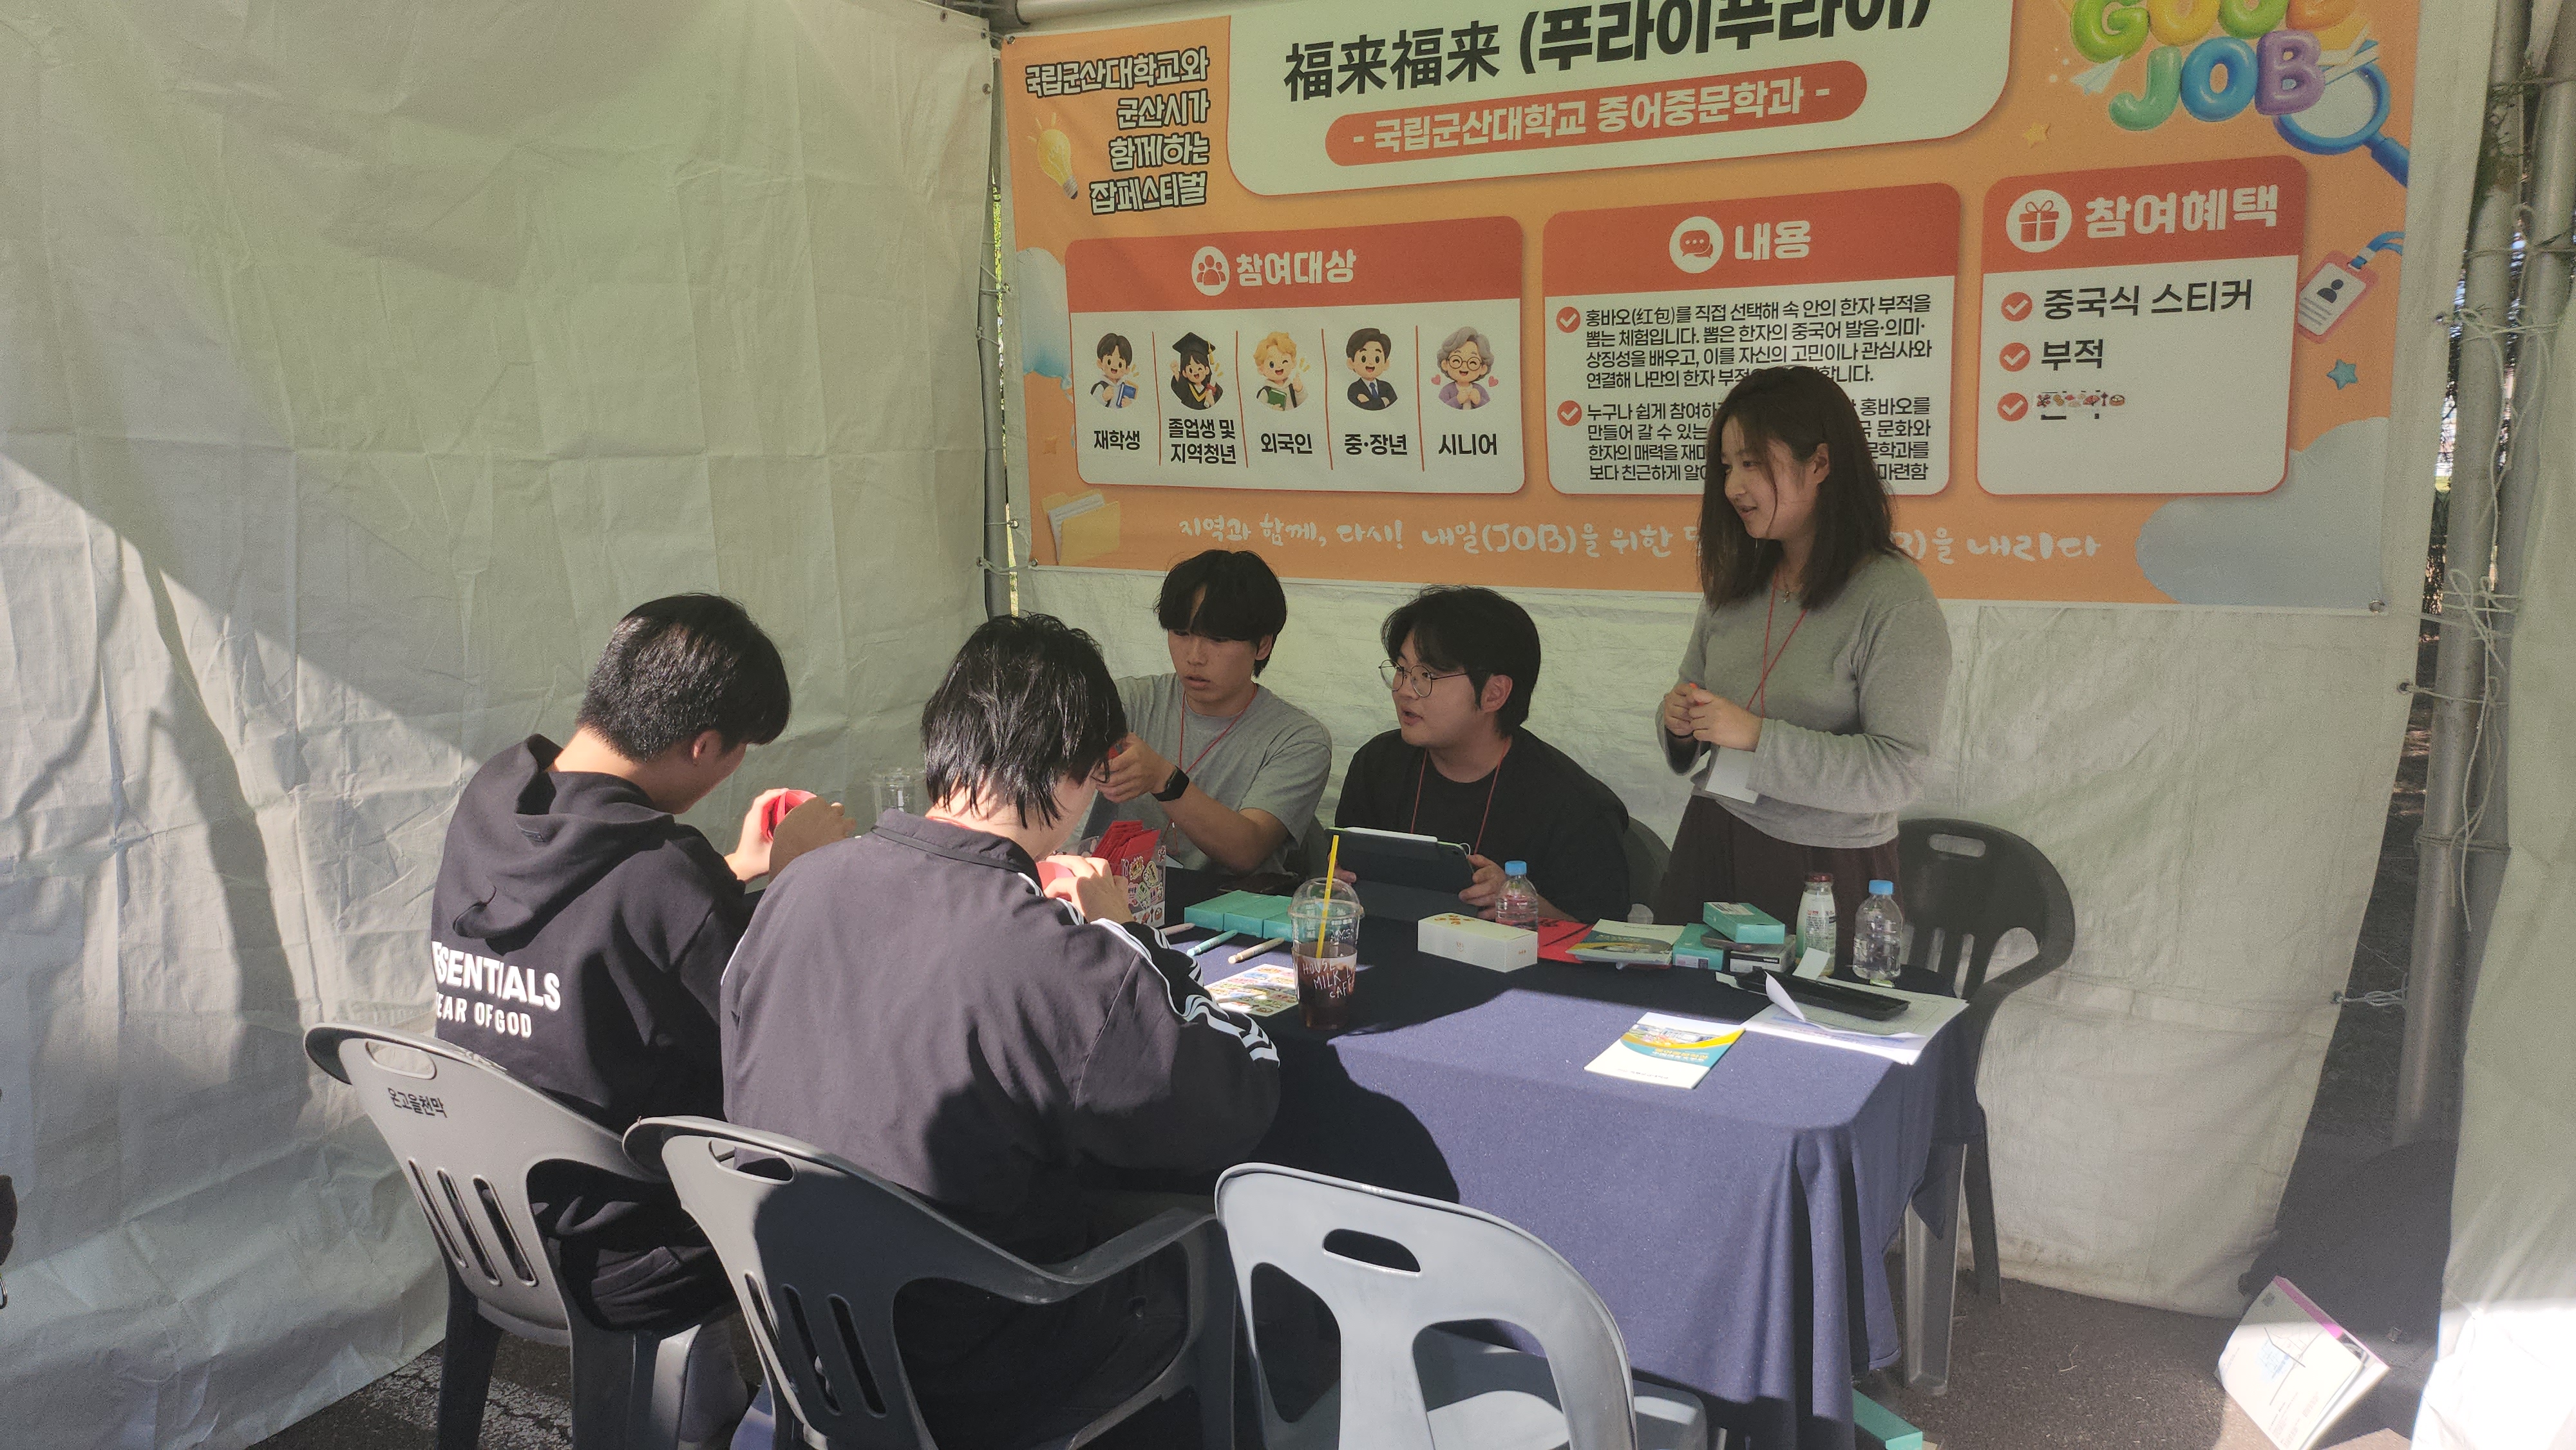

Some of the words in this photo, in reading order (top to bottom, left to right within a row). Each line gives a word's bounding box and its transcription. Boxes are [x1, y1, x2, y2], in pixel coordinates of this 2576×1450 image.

[1026, 46, 1209, 97] 국립군산대학교와
[1284, 21, 1499, 102] 福来福来
[2108, 30, 2325, 131] JOB
[1117, 89, 1210, 129] 군산시가
[1374, 100, 1586, 153] 국립군산대학교
[1596, 77, 1802, 133] 중어중문학과
[1109, 132, 1209, 171] 함께하는
[1090, 171, 1207, 215] 잡페스티벌
[2085, 185, 2278, 238] 참여혜택
[1734, 220, 1811, 261] 내용
[1236, 249, 1356, 287] 참여대상
[1586, 306, 1691, 327] 홍바오(红包)를
[1695, 304, 1726, 323] 직접
[1730, 302, 1779, 321] 선택해
[1783, 301, 1799, 318] 속
[1803, 299, 1835, 317] 안의
[1841, 297, 1875, 316] 한자
[1878, 294, 1931, 314] 부적을
[2043, 285, 2139, 319] 중국식
[2151, 279, 2252, 314] 스티커
[1586, 330, 1615, 348] 뽑는
[1619, 327, 1700, 346] 체험입니다.
[1703, 325, 1736, 344] 뽑은
[1739, 323, 1787, 342] 한자의
[1792, 321, 1841, 340] 중국어
[1586, 350, 1645, 368] 상징성을
[1649, 349, 1700, 368] 배우고,
[1703, 347, 1735, 365] 이를
[1739, 345, 1786, 364] 자신의
[1791, 343, 1859, 362] 고민이나
[1861, 339, 1932, 360] 관심사와
[2041, 339, 2103, 370] 부적
[1586, 371, 1631, 390] 연결해
[1634, 370, 1679, 388] 나만의
[1683, 369, 1715, 387] 한자
[1587, 404, 1633, 420] 누구나
[1636, 403, 1665, 420] 쉽게
[1860, 397, 1930, 416] 홍바오를
[1094, 429, 1140, 451] 재학생
[1168, 419, 1215, 440] 졸업생
[1218, 418, 1235, 439] 및
[1588, 424, 1633, 440] 만들어
[1638, 424, 1652, 440] 갈
[1657, 424, 1672, 440] 수
[1677, 423, 1707, 440] 있는
[1877, 419, 1931, 437] 문화와
[1170, 444, 1236, 465] 지역청년
[1260, 433, 1312, 455] 외국인
[1344, 433, 1406, 457] 중·장년
[1439, 433, 1497, 457] 시니어
[1589, 444, 1631, 461] 한자의
[1635, 444, 1678, 461] 매력을
[1589, 465, 1619, 480] 보다
[1622, 464, 1681, 481] 친근하게
[1877, 463, 1928, 480] 마련함
[1179, 514, 1251, 542] 지역과
[1260, 513, 1327, 547] 함께,
[1336, 520, 1403, 549] 다시!
[1422, 522, 1600, 558] 내일(JOB)을
[1610, 523, 1672, 558] 위한
[1967, 532, 2101, 562] 내리다
[1313, 970, 1341, 990] MILK
[437, 992, 467, 1022] EAR
[495, 1009, 533, 1038] GOD
[388, 1088, 448, 1118] 온고을천막
